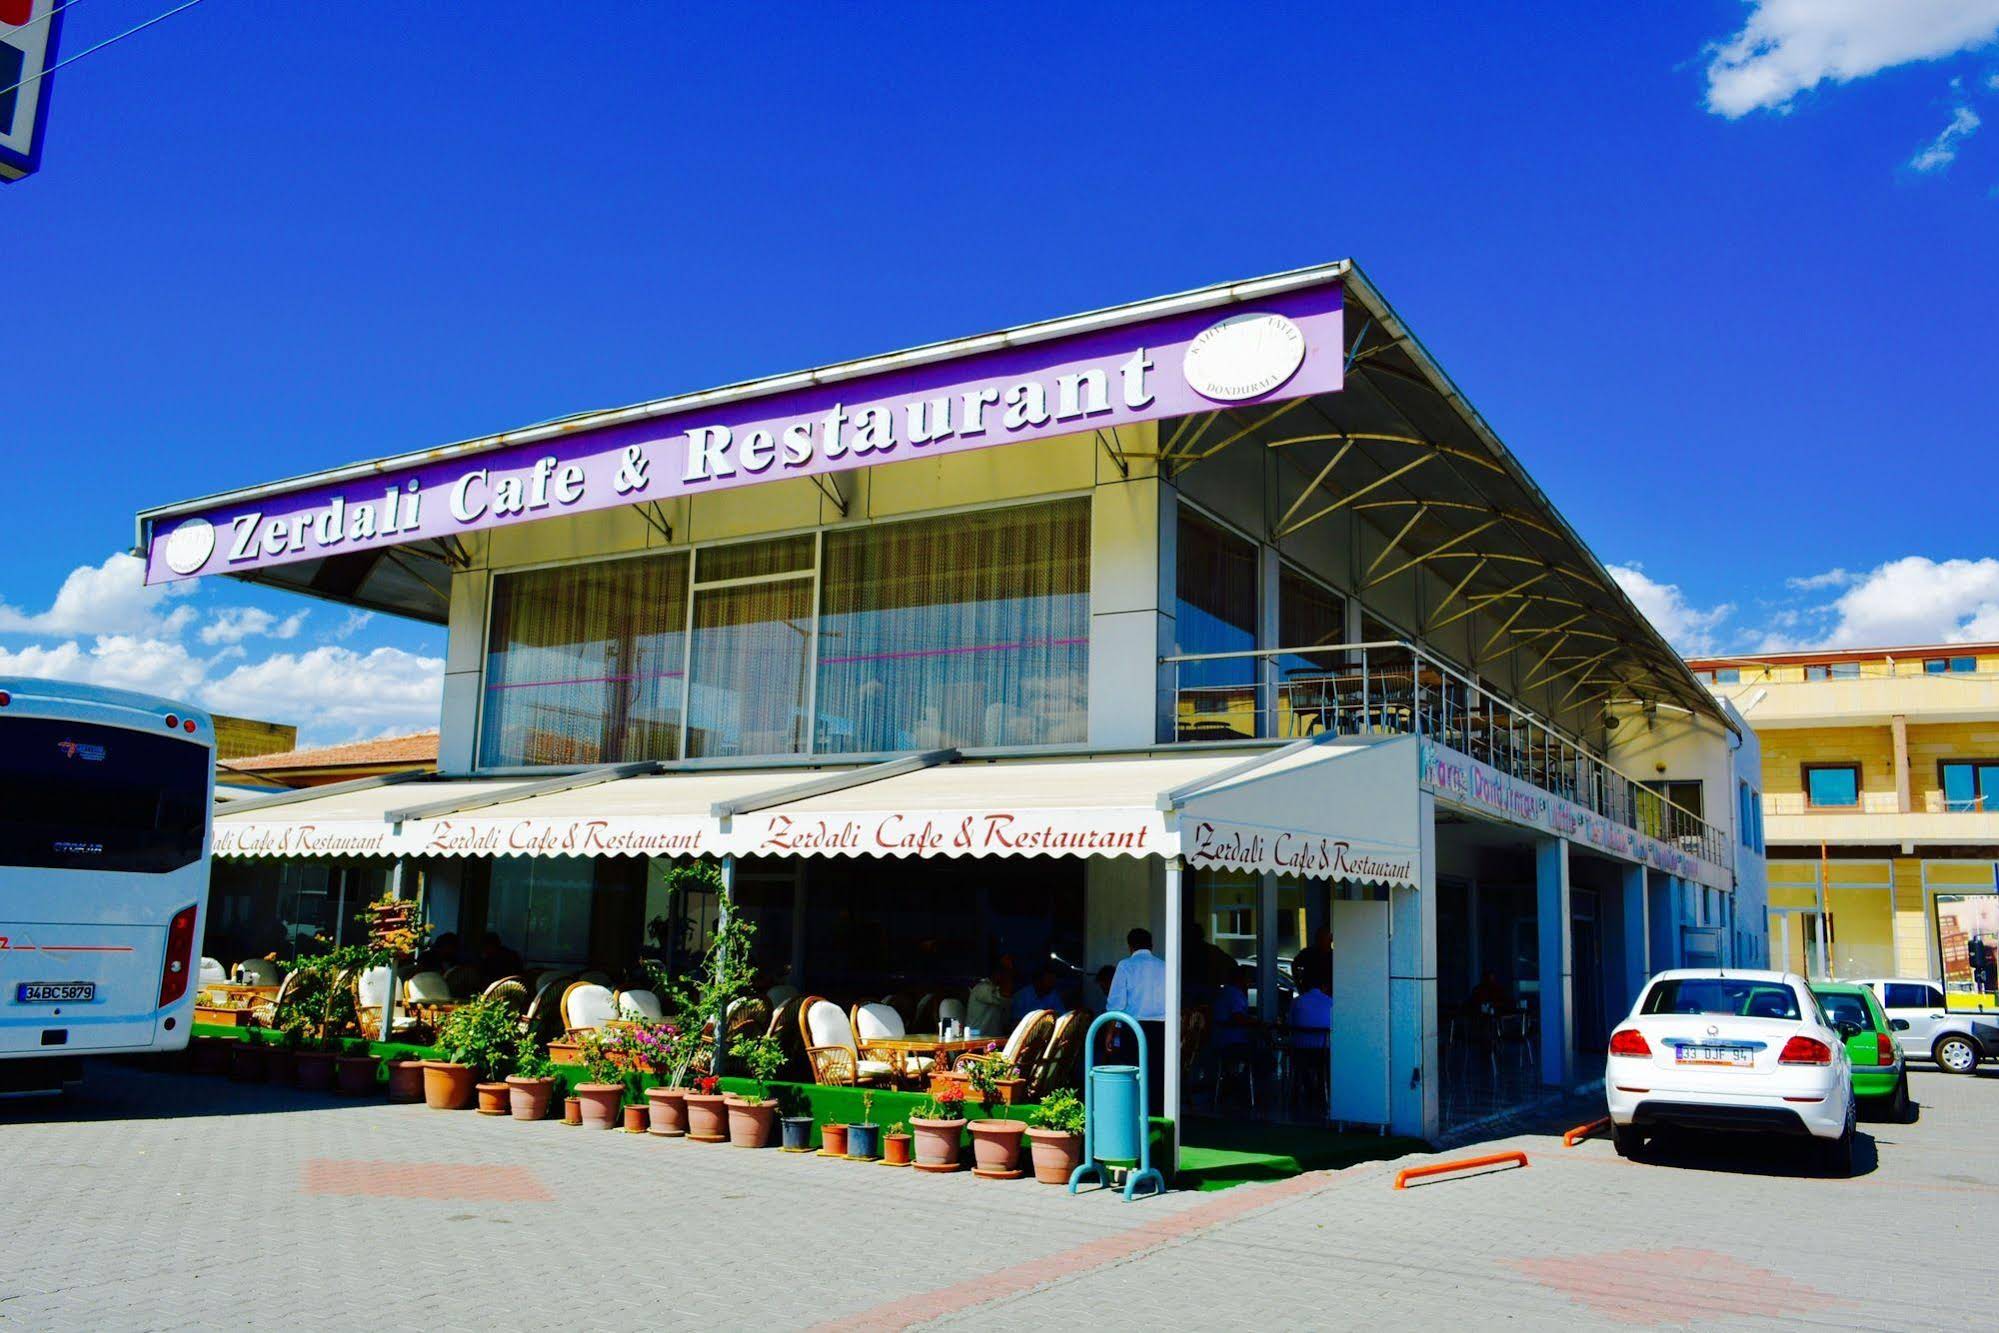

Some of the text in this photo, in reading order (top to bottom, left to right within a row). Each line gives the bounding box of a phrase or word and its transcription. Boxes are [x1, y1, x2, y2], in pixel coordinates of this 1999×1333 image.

[1206, 374, 1279, 396] DONDURMA
[227, 478, 421, 564] Zerdali
[450, 456, 585, 524] Cafe
[614, 444, 650, 496] &
[682, 347, 1156, 484] Restaurant
[238, 825, 273, 853] Cafe
[278, 827, 292, 850] &
[295, 825, 384, 850] Restaurant
[426, 820, 702, 855] Zerdali Cafe & Restaurant
[761, 814, 1148, 855] Zerdali Cafe & Restaurant
[1191, 822, 1411, 880] Zerdali Cafe & Restaurant
[1683, 1047, 1747, 1061] 33 DJF 94
